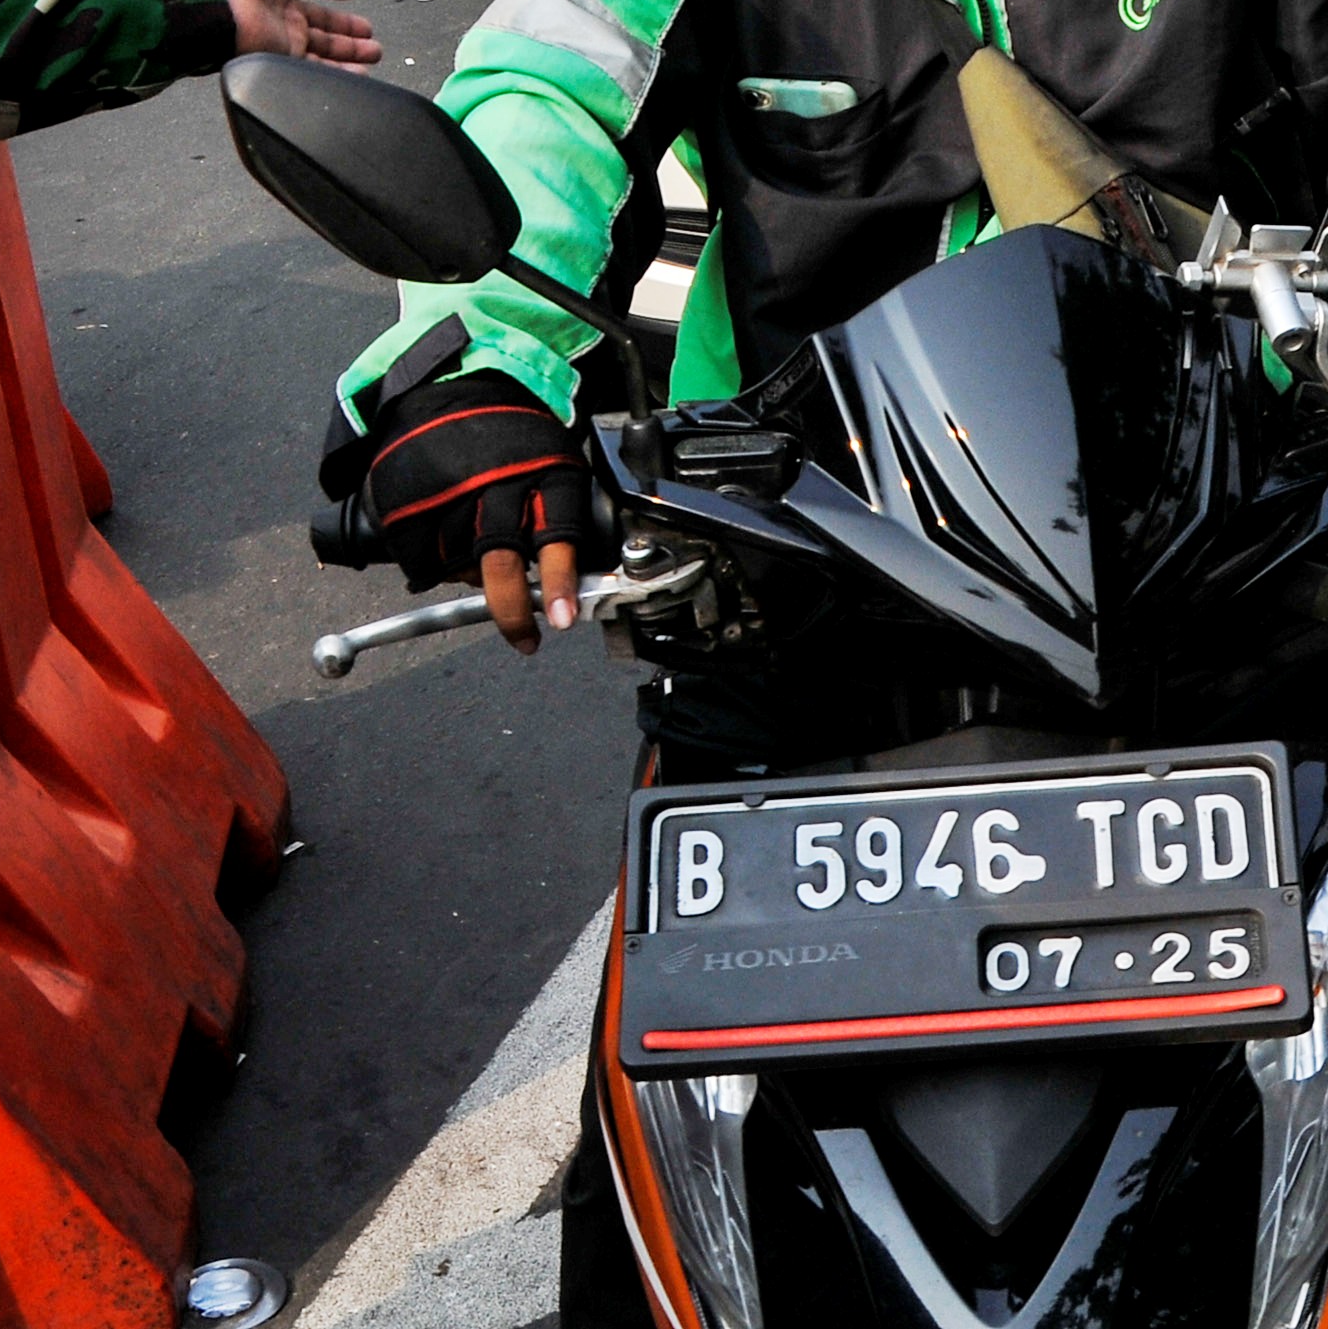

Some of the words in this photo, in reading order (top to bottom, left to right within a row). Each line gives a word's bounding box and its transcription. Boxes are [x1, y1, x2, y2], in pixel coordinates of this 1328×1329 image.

[676, 830, 724, 917] B
[794, 808, 1047, 911] 5946
[1076, 793, 1251, 889] TGD
[703, 940, 860, 972] HONDA
